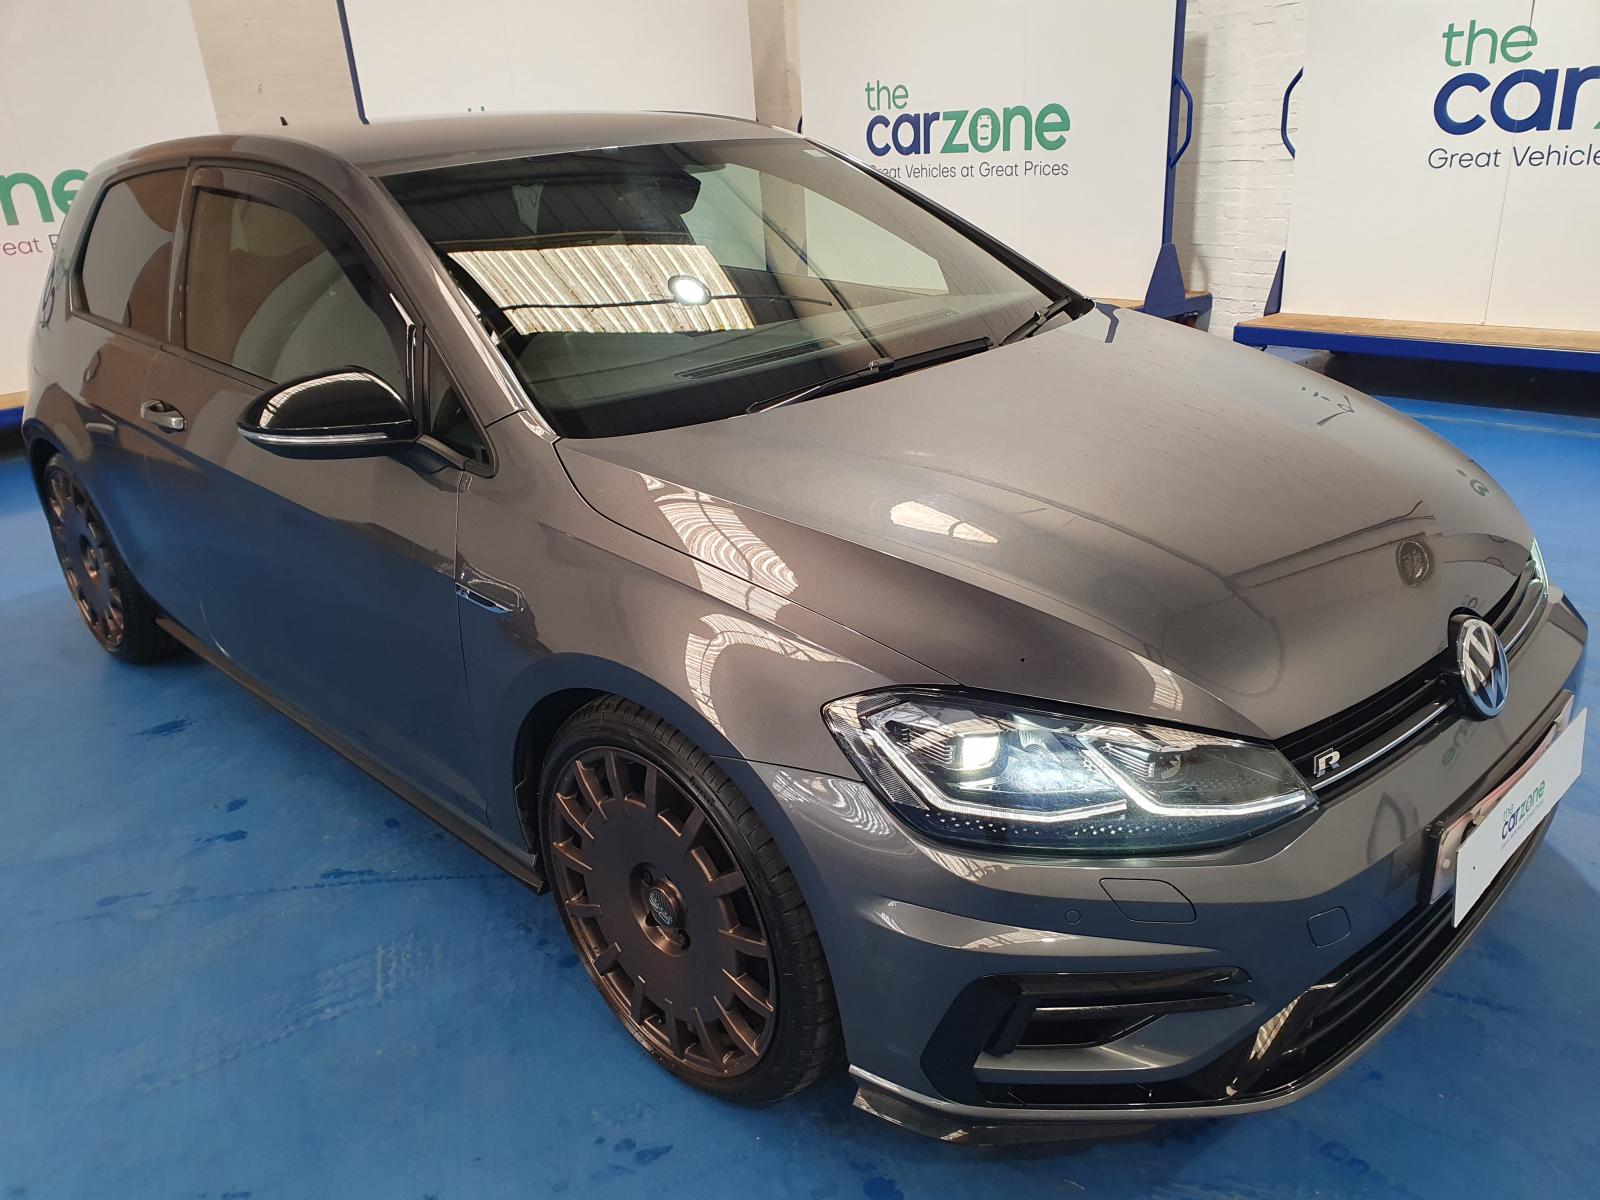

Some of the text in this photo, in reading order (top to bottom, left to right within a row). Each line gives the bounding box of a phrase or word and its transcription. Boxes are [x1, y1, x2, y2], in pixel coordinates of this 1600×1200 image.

[1441, 20, 1539, 67] the
[864, 80, 909, 111] the
[1433, 65, 1600, 136] car
[866, 103, 1071, 157] carzone
[904, 162, 957, 179] Vehicles
[960, 163, 975, 178] at
[978, 161, 1019, 178] Great
[1024, 160, 1069, 177] Prices
[1428, 147, 1502, 169] Great
[0, 237, 43, 256] eat
[1501, 780, 1546, 840] carzone
